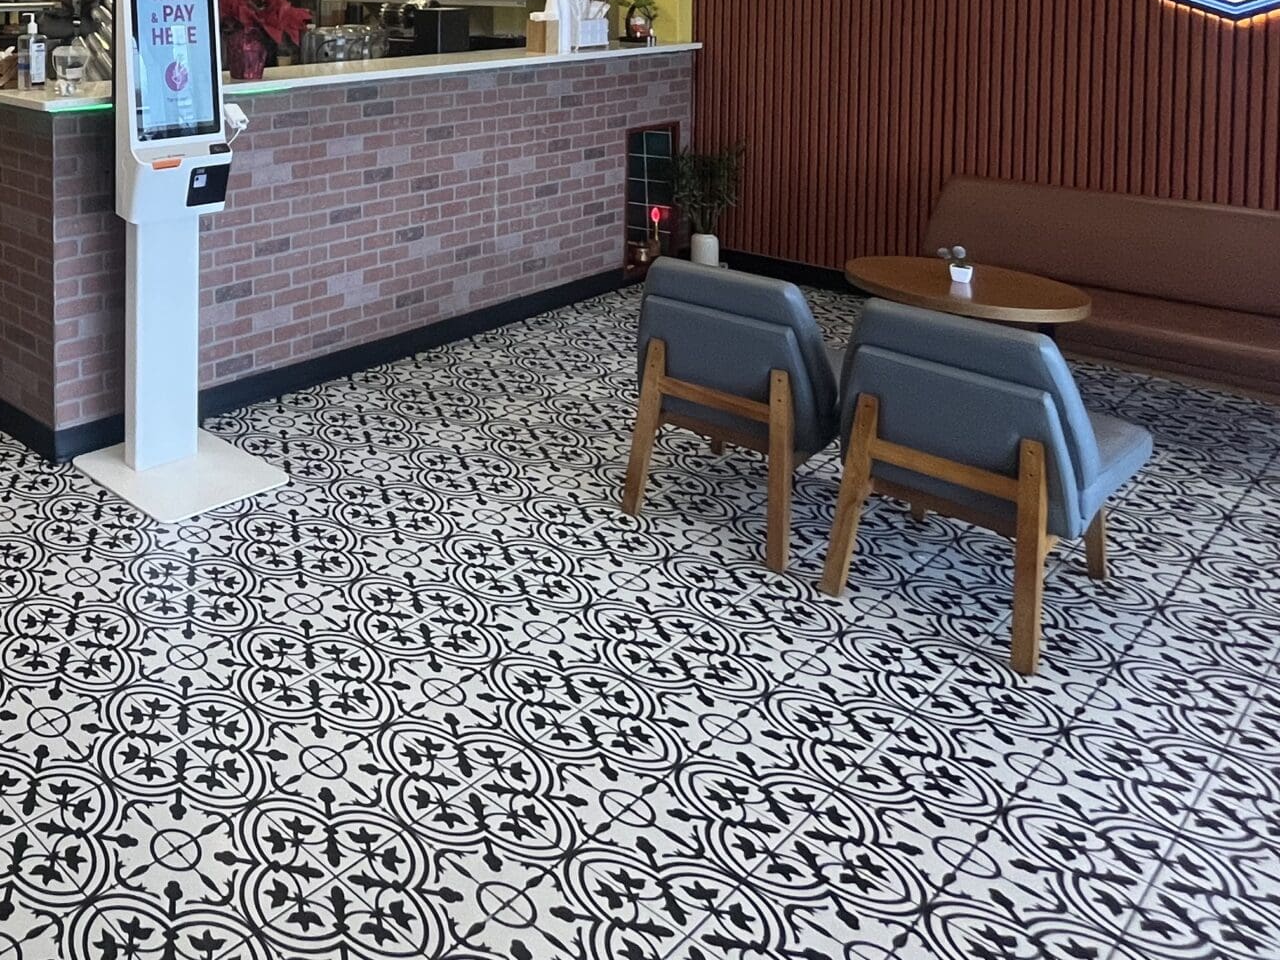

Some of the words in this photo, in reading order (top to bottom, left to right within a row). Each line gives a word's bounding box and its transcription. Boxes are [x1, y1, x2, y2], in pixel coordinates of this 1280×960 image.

[151, 12, 158, 23] &
[162, 3, 195, 23] PAY
[151, 25, 198, 46] HEE
